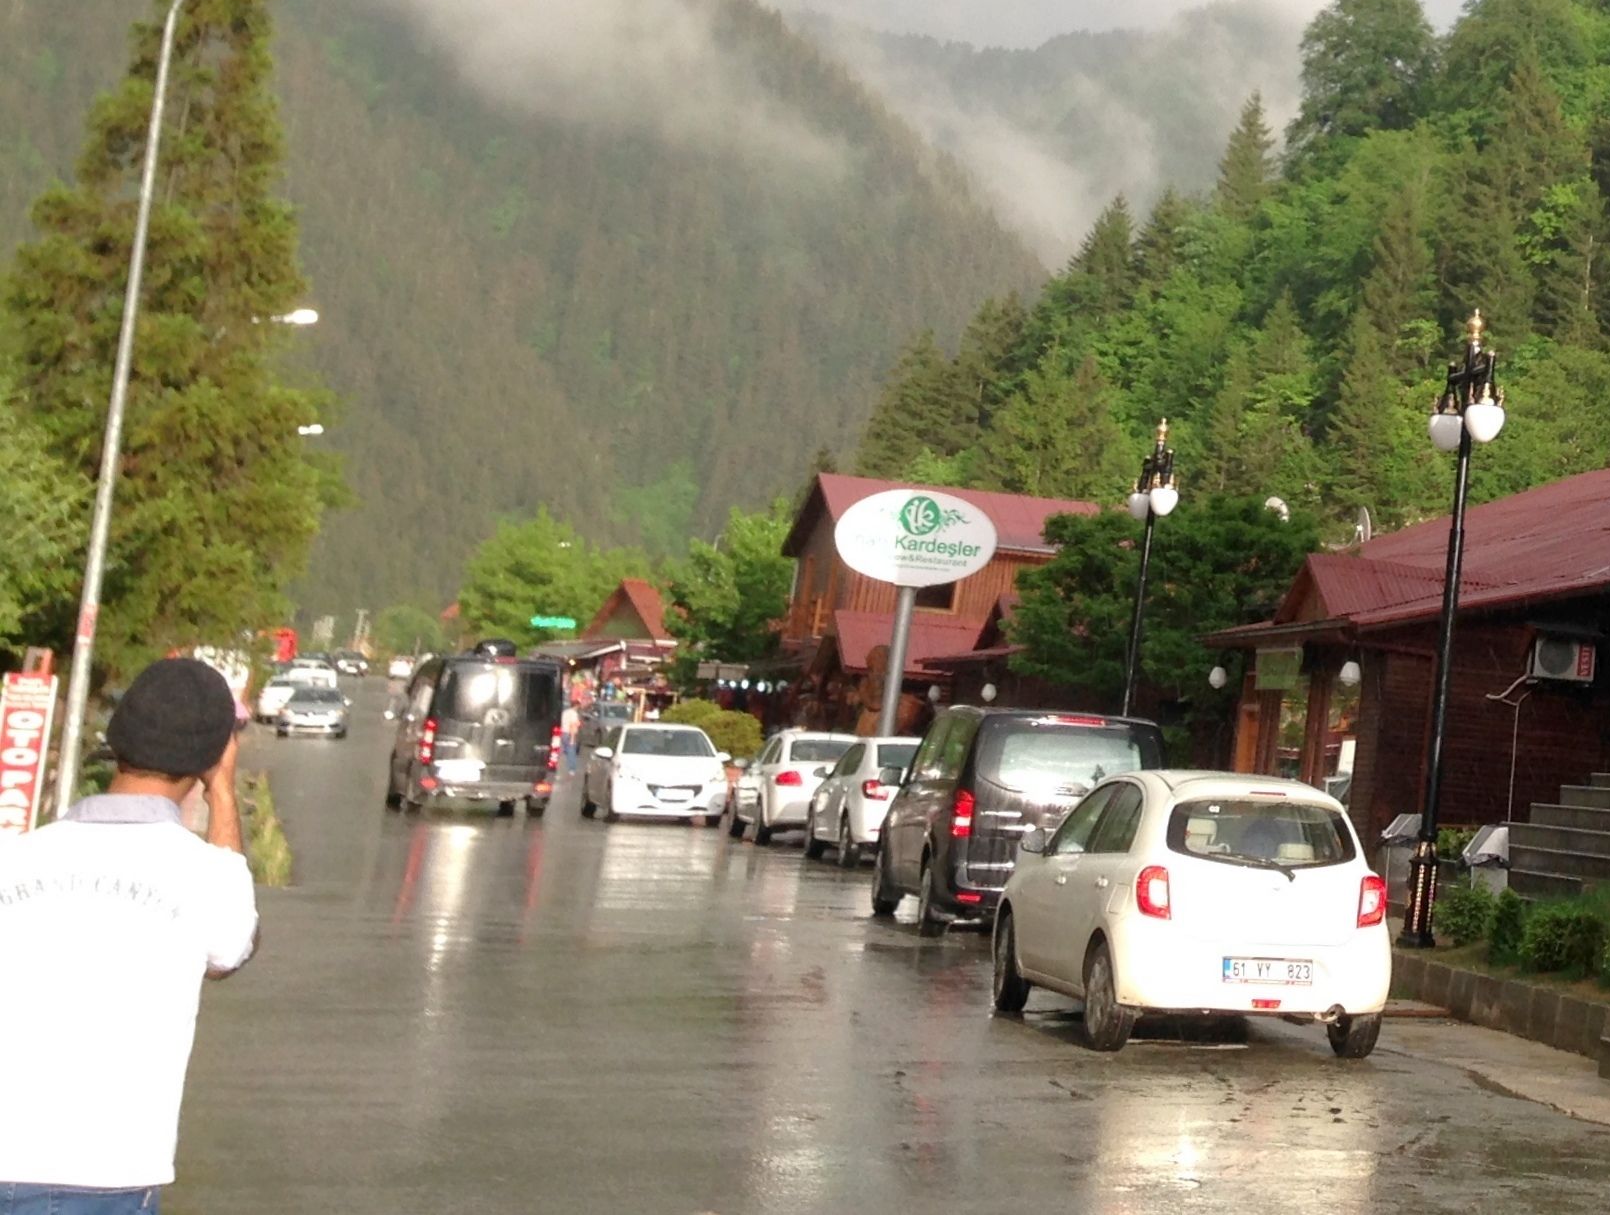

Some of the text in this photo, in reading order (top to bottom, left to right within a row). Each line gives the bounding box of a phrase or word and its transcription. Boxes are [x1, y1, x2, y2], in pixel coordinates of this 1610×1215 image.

[895, 534, 982, 558] Kardeşler
[0, 710, 44, 833] OTOPAR
[1232, 961, 1246, 977] 61
[1287, 963, 1310, 980] 823
